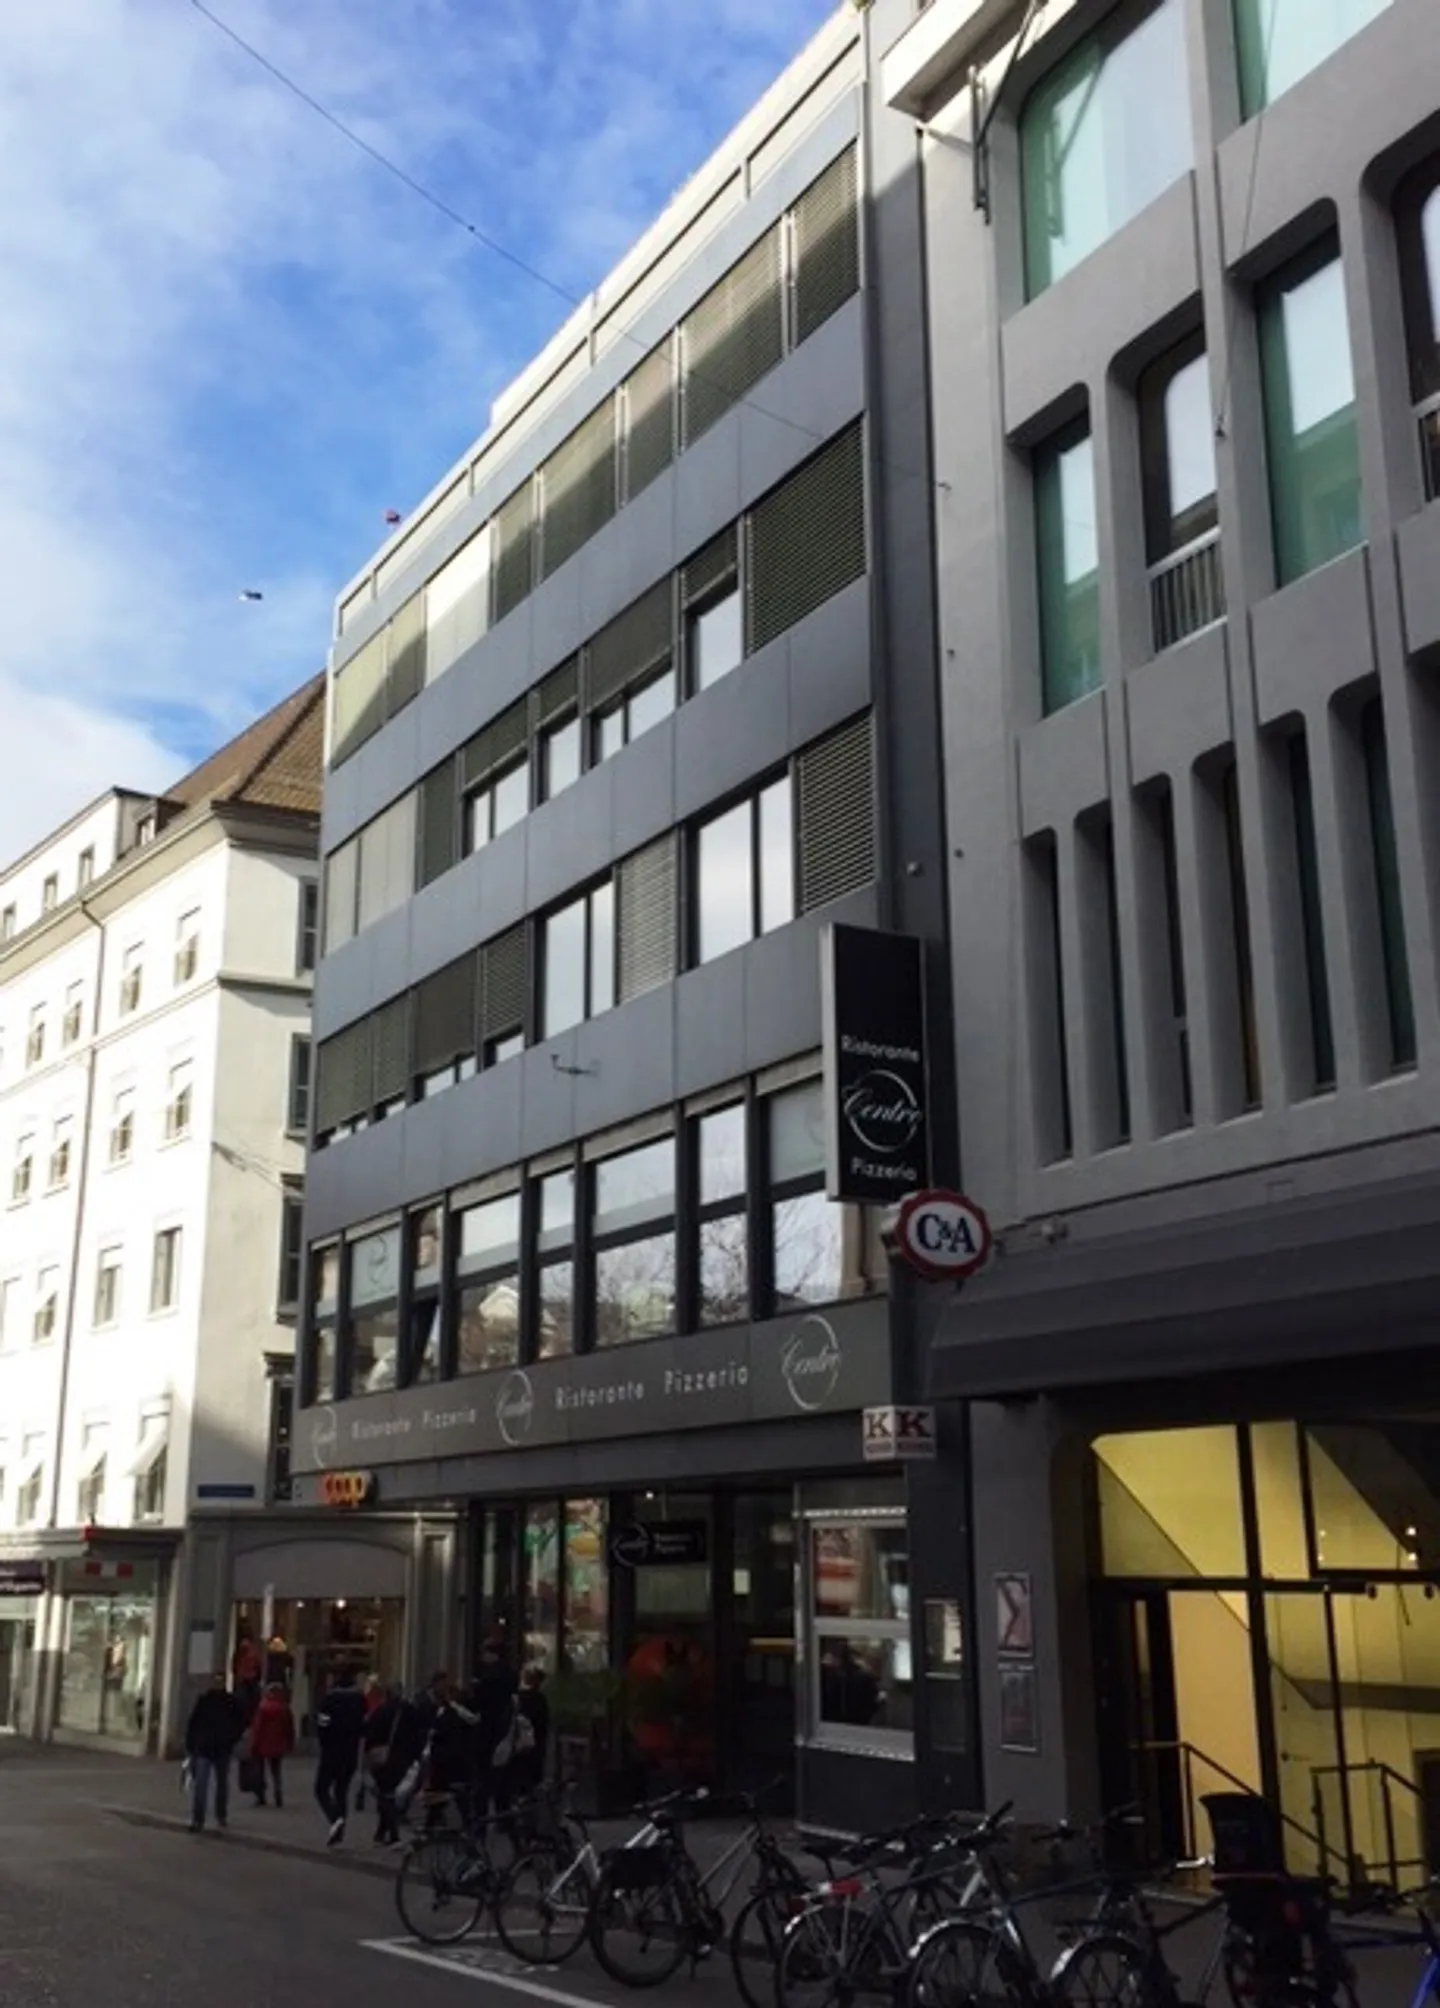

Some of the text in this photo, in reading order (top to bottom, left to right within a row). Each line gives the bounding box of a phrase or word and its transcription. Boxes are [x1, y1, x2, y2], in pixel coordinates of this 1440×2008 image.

[841, 1034, 919, 1062] Ristorante
[851, 1156, 918, 1181] Pizzeria
[916, 1211, 977, 1254] C&A
[556, 1380, 645, 1410] Ristorante
[664, 1360, 749, 1395] Pizzeria
[896, 1410, 932, 1438] K
